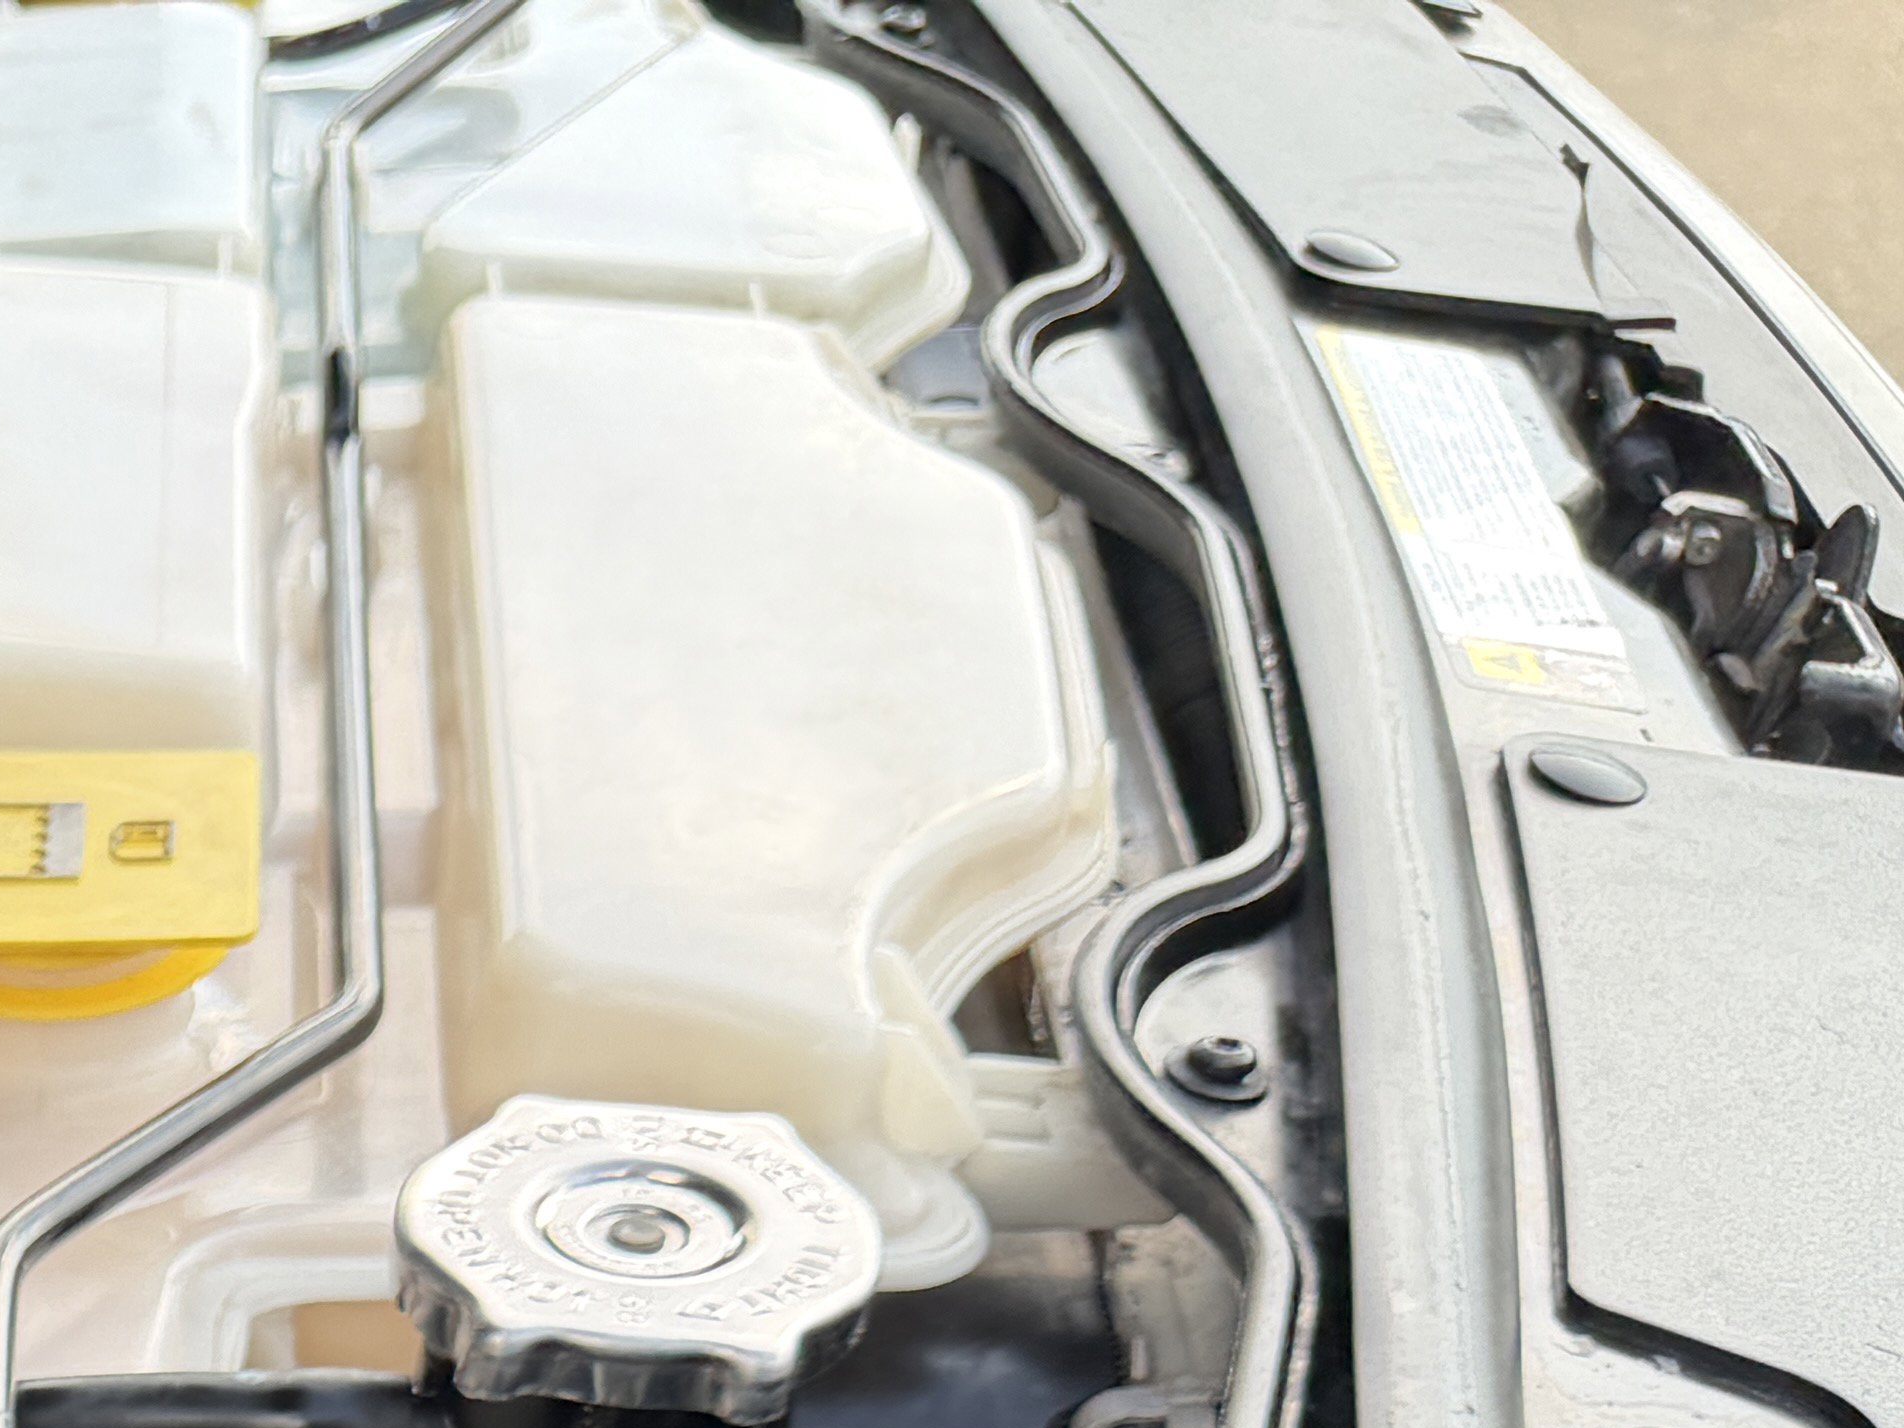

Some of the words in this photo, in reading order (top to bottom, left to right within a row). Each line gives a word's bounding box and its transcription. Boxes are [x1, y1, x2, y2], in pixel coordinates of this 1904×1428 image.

[454, 1130, 536, 1182] NOT
[534, 1114, 608, 1146] DO
[432, 1184, 498, 1270] OPEN
